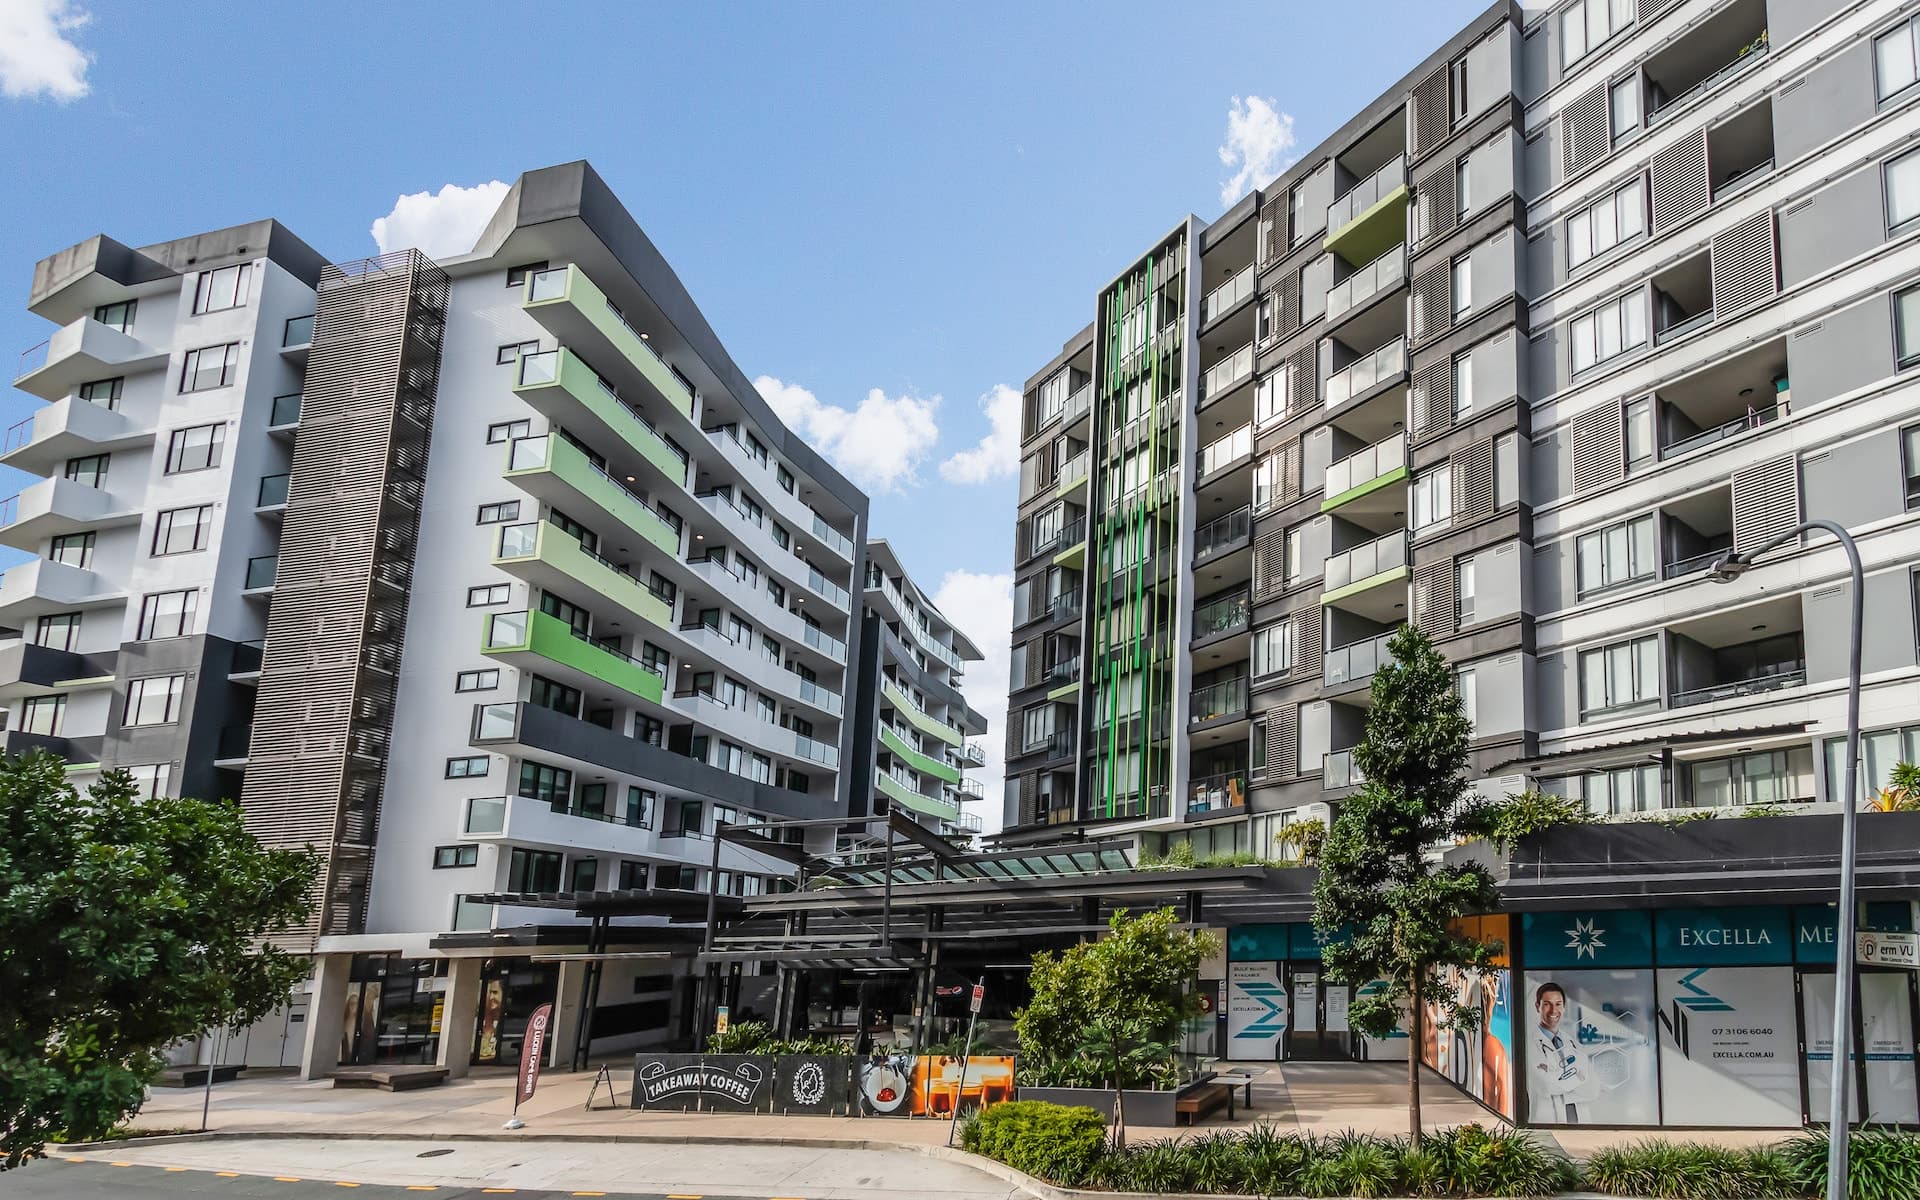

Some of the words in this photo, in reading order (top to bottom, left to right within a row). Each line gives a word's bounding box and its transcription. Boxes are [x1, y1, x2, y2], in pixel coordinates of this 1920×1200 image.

[1680, 927, 1772, 946] EXCELLA
[1899, 945, 1914, 956] VU
[648, 1073, 709, 1097] TAKEAWAY
[710, 1076, 750, 1100] COFFEE
